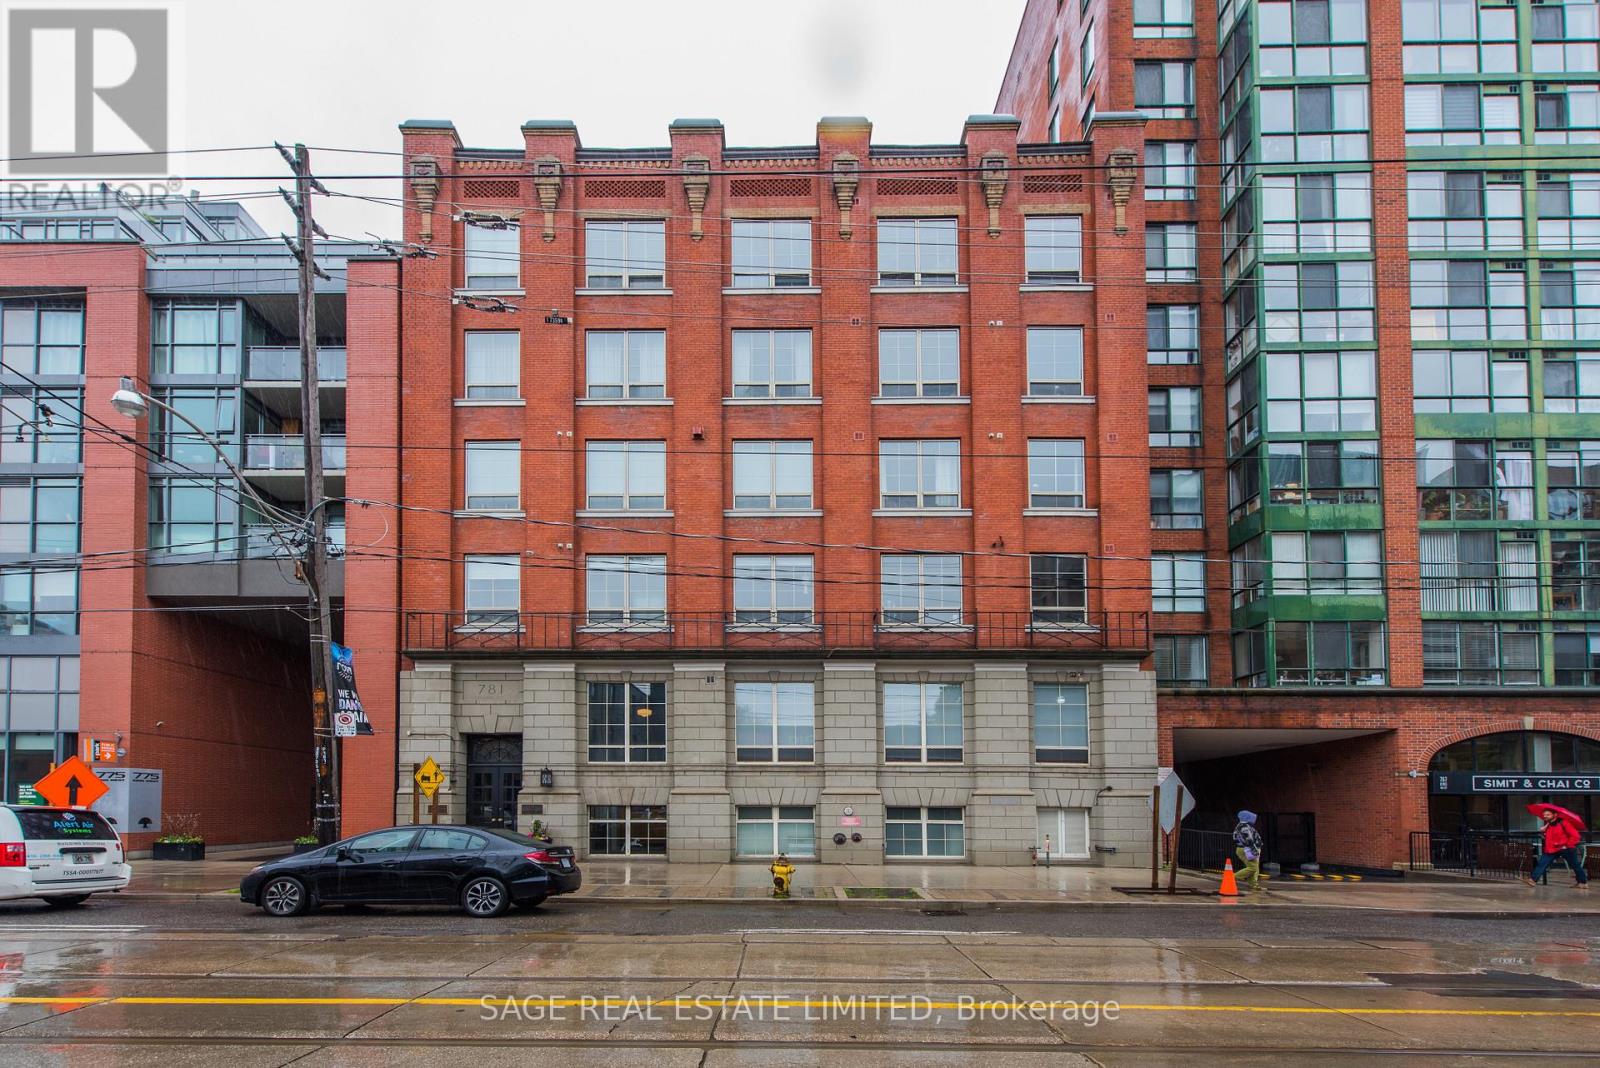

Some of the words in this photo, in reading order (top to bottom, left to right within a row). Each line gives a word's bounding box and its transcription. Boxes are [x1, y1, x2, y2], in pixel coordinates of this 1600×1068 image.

[337, 688, 350, 699] WE
[477, 684, 503, 695] 781
[95, 771, 126, 779] 775
[132, 771, 160, 780] 775
[1483, 779, 1518, 788] SIMIT
[1523, 779, 1533, 788] &
[1538, 779, 1570, 788] CHAI
